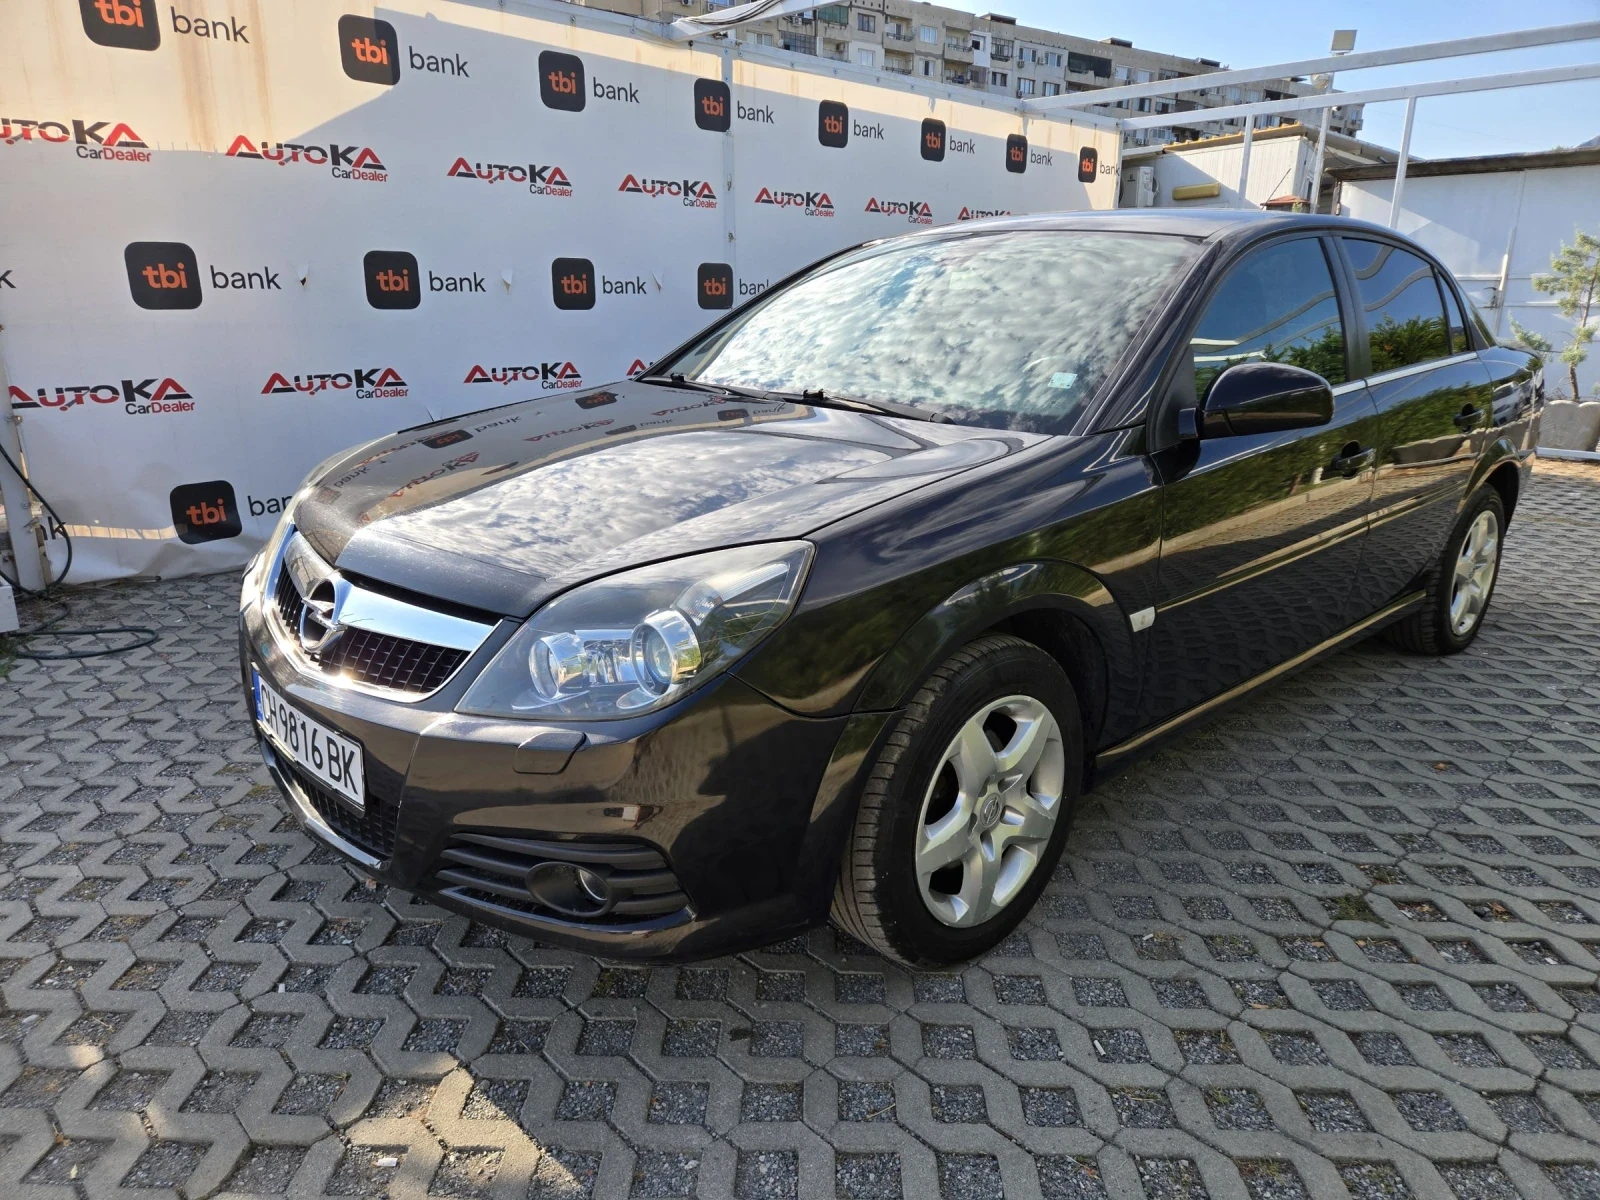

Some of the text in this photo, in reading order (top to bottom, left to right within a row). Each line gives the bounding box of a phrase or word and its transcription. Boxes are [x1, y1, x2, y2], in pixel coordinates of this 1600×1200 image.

[94, 0, 250, 44] tbi bank
[352, 37, 470, 77] tbi bank
[548, 71, 640, 103] tbi bank
[702, 96, 774, 124] tbi bank
[824, 116, 884, 140] tbi bank
[76, 145, 152, 162] CarDealer
[925, 132, 976, 155] tbi bank
[1010, 146, 1053, 166] tbi bank
[331, 167, 389, 182] CarDealer
[1081, 157, 1120, 177] tbi bank
[529, 184, 573, 197] CarDealer
[682, 197, 718, 209] CarDealer
[804, 207, 835, 217] CarDealer
[957, 206, 1011, 220] AUTOK
[907, 215, 934, 225] CarDealer
[142, 263, 282, 290] tbi bank
[376, 269, 487, 292] tbi bank
[561, 274, 647, 294] tbi bank
[703, 277, 726, 295] tbi
[355, 387, 409, 400] CarDealer
[541, 379, 583, 390] CarDealer
[125, 402, 195, 415] CarDealer
[186, 495, 293, 525] tbi ban
